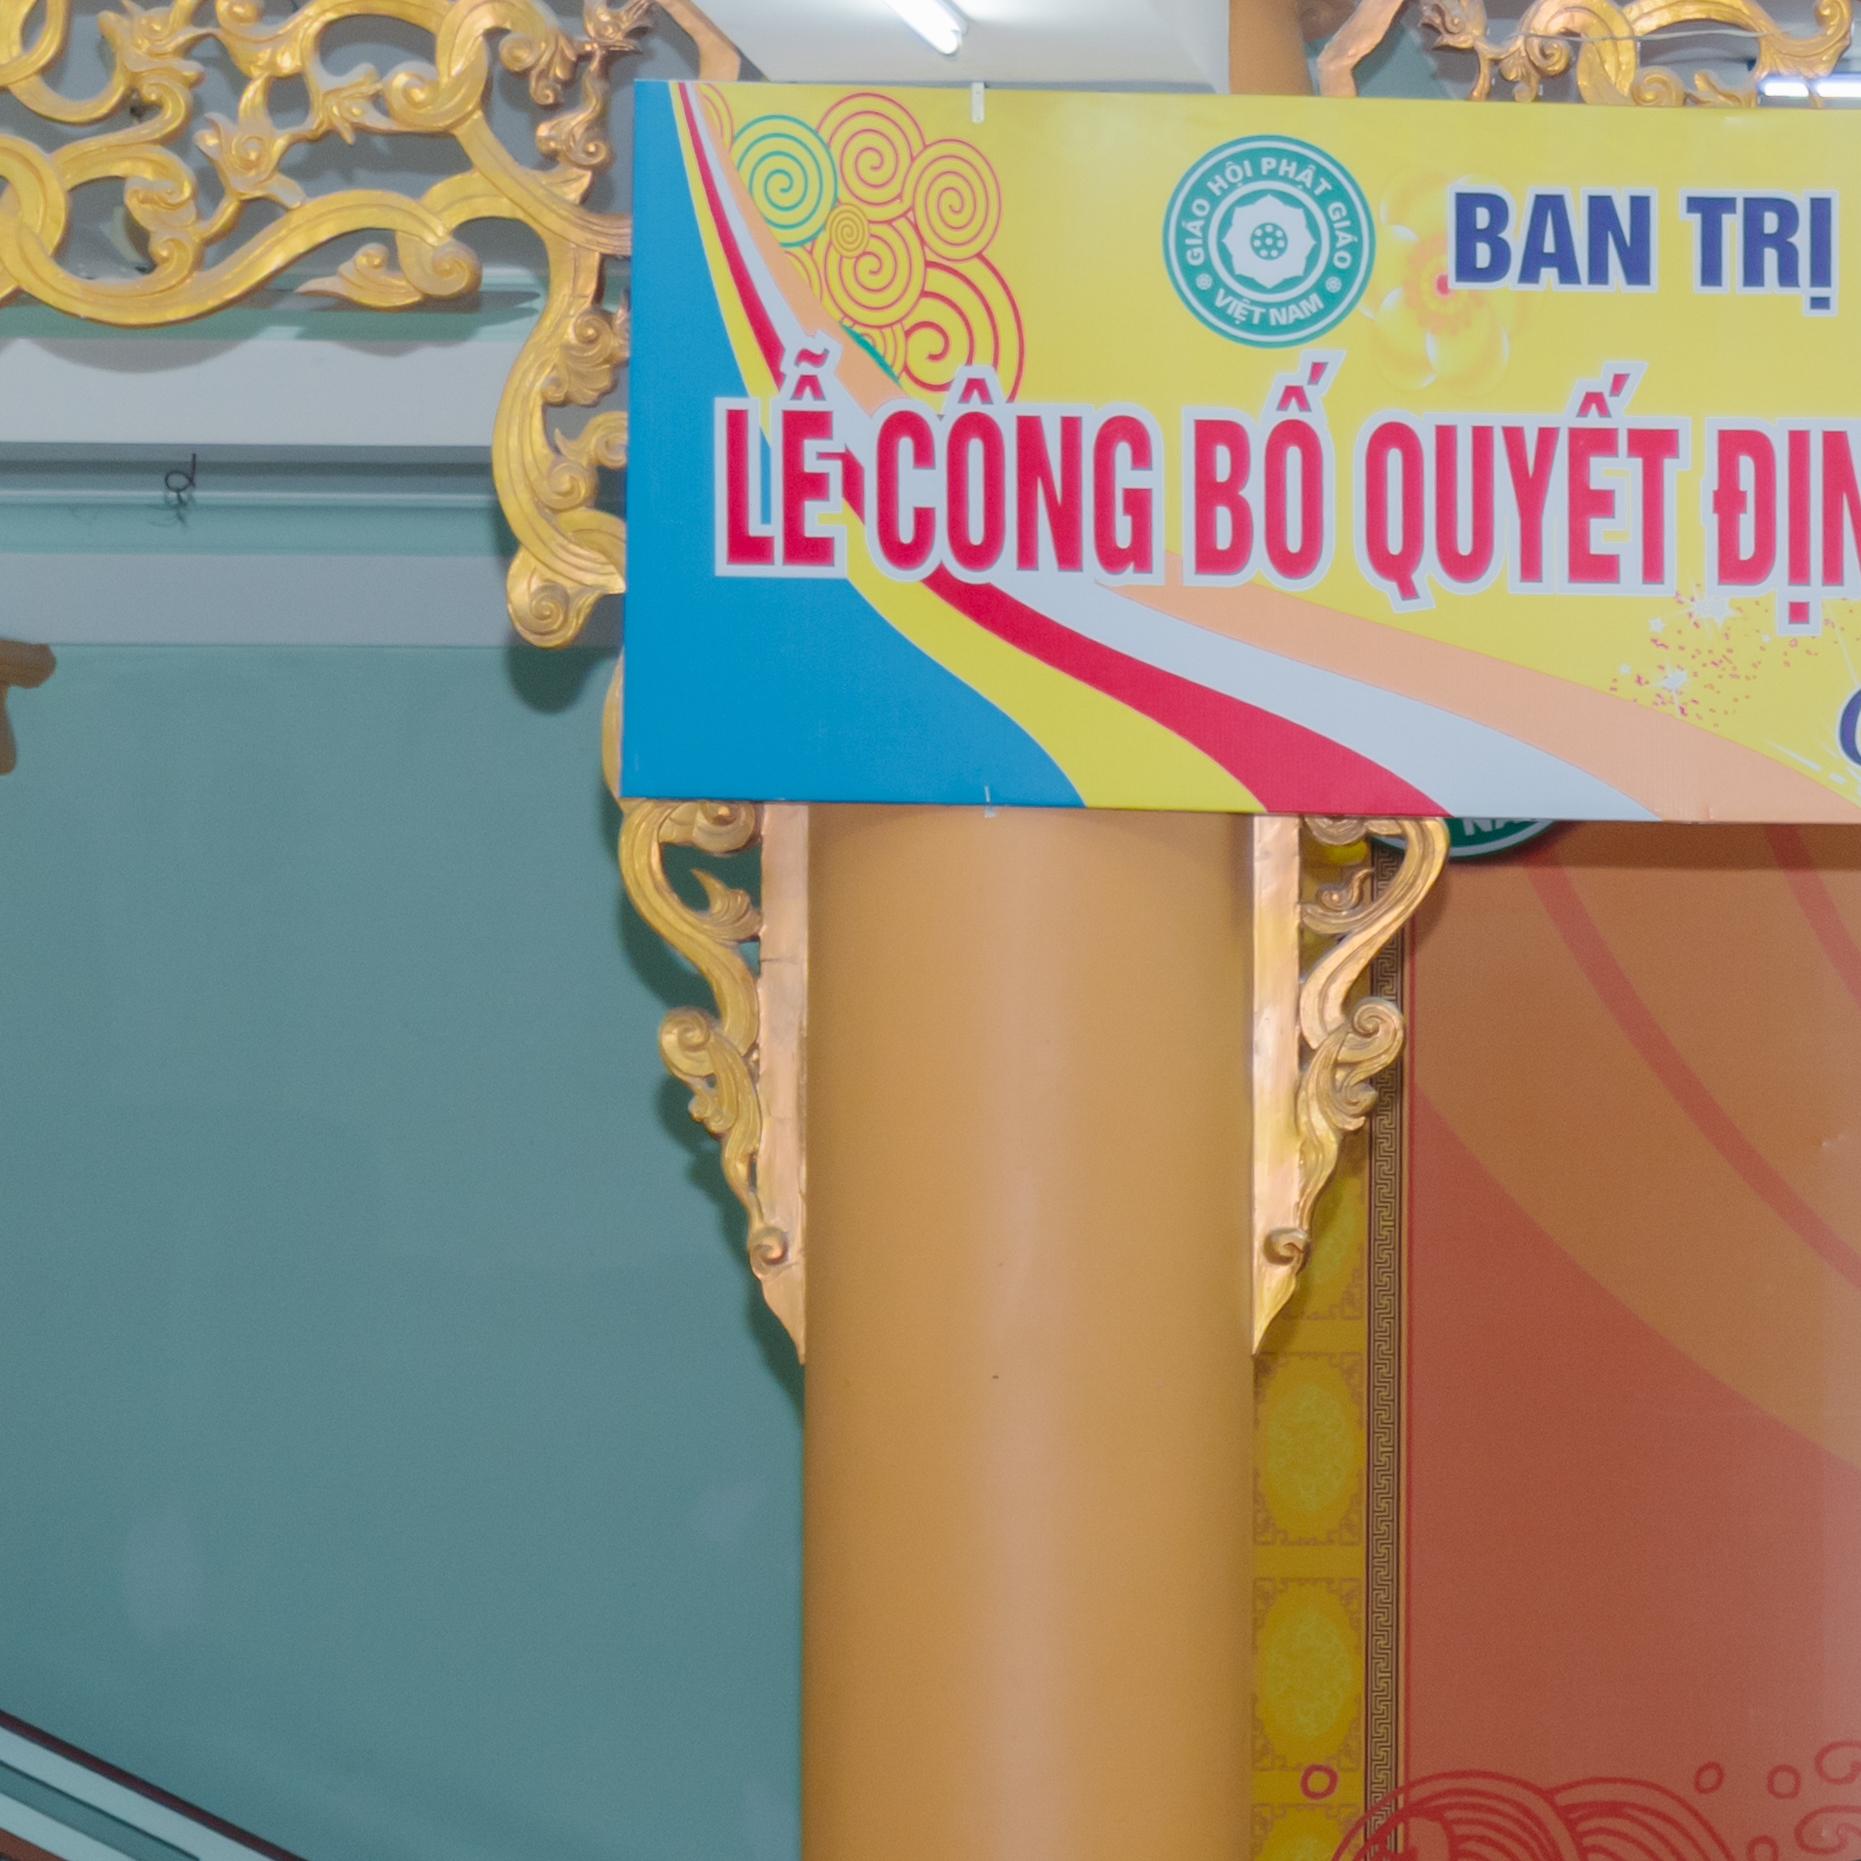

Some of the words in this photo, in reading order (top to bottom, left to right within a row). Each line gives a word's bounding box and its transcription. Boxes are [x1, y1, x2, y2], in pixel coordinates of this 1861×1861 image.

[1181, 199, 1211, 266] GIÁO
[1207, 161, 1253, 196] HỘI
[1261, 157, 1332, 196] PHẬT
[1327, 201, 1358, 269] GIÁO
[1452, 191, 1653, 288] BAN
[1686, 195, 1836, 312] TRỊ
[1214, 288, 1266, 324] VIỆT
[1269, 293, 1324, 326] NAM
[723, 350, 838, 570] LỄ
[874, 378, 1156, 580] CÔNG
[1195, 362, 1329, 580] BỐ
[1365, 373, 1683, 601] QUYẾT
